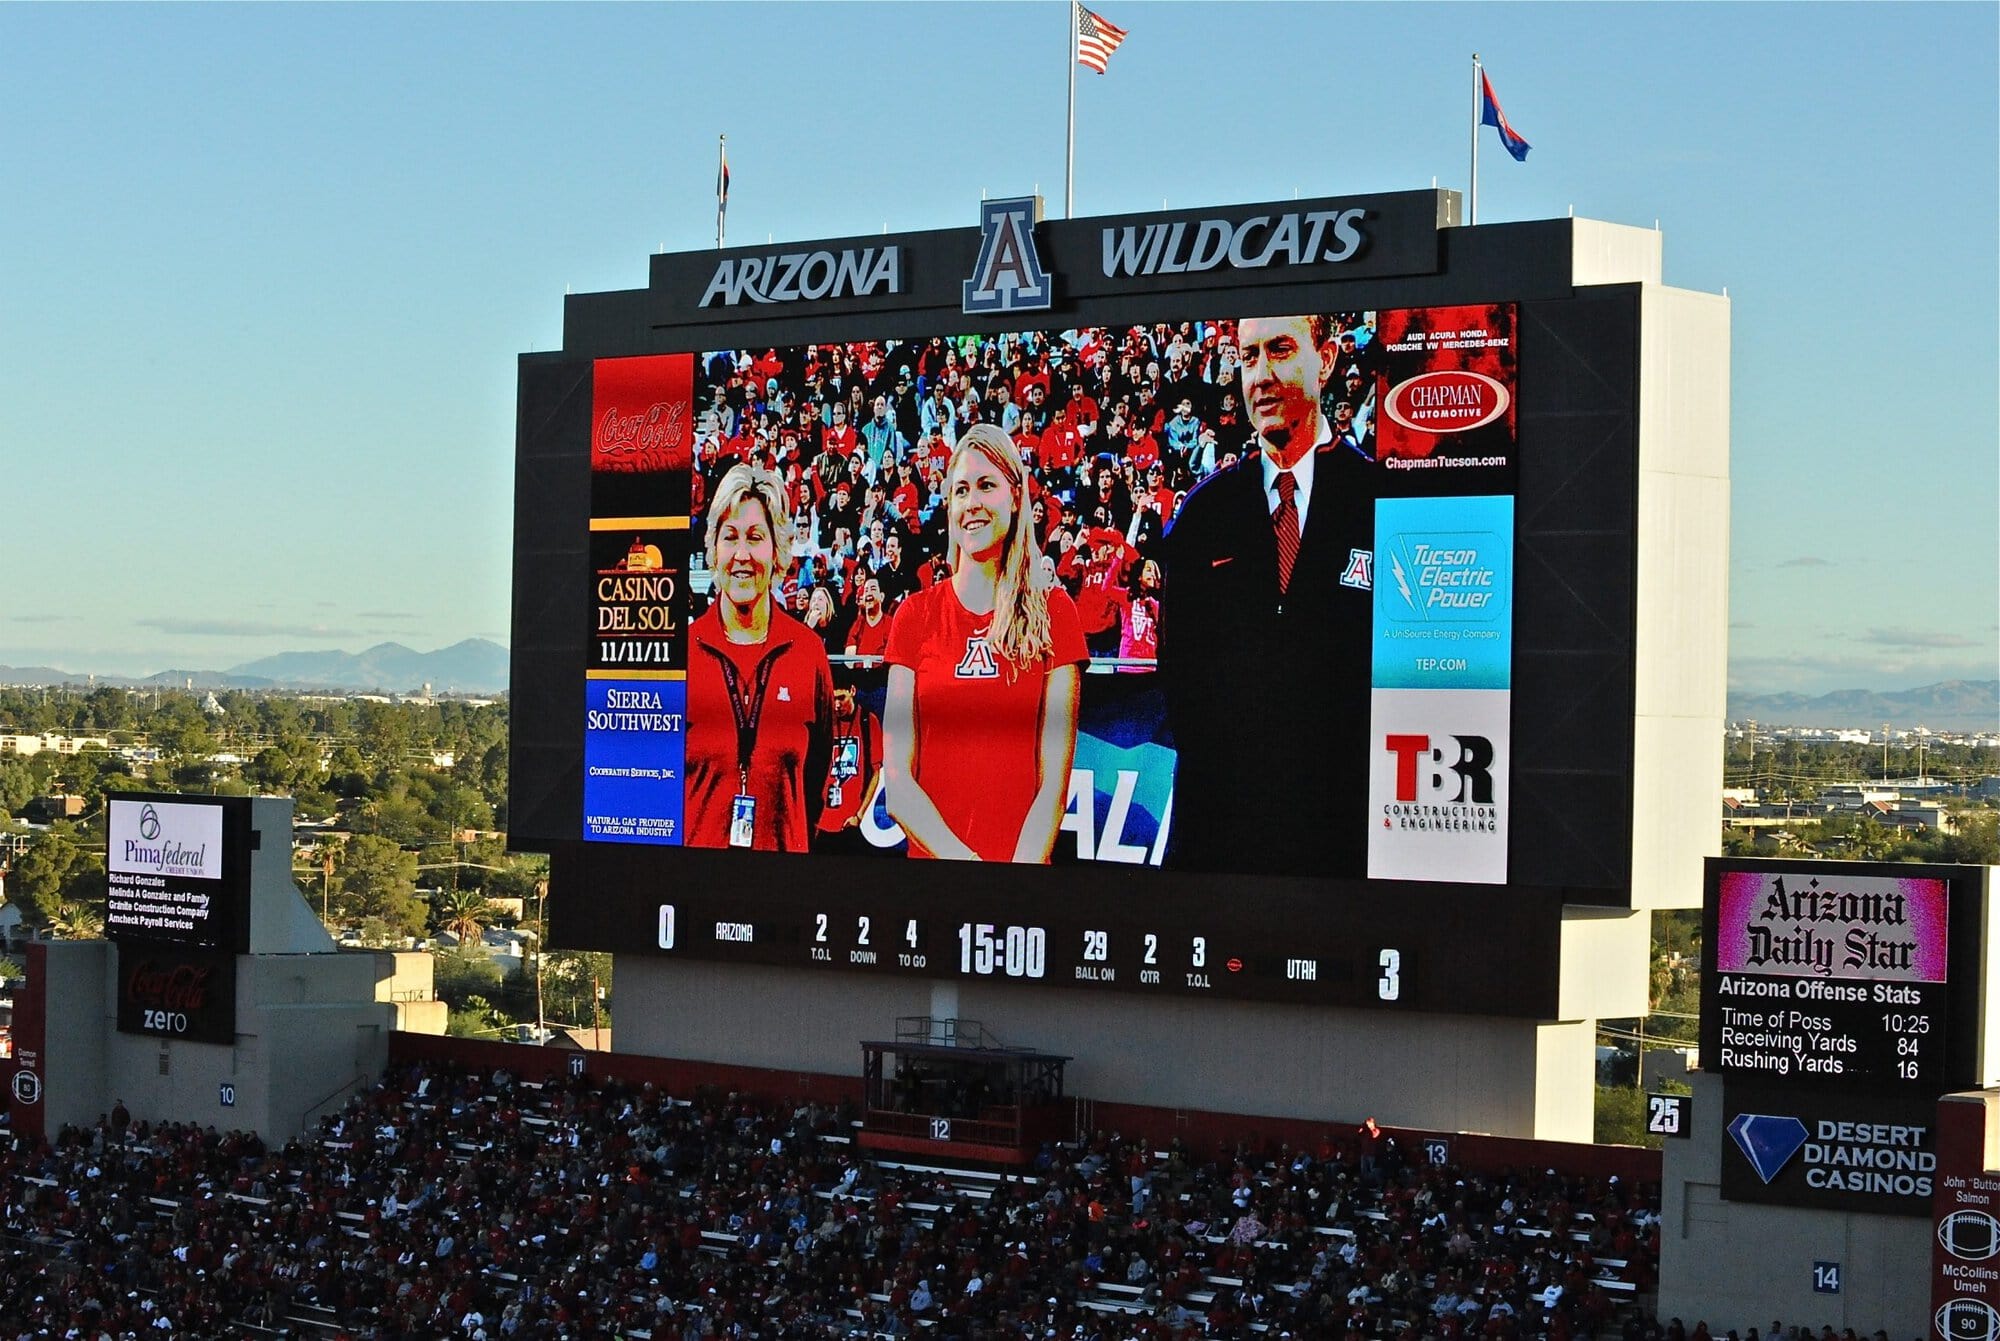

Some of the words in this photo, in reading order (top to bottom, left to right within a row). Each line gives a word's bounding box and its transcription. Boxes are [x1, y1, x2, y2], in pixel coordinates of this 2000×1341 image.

[698, 246, 899, 308] ARIZONA
[962, 197, 1053, 314] A
[1101, 208, 1366, 278] WILDCATS
[1386, 343, 1422, 352] PORSCHE
[1426, 342, 1438, 350] VW
[1442, 338, 1509, 349] MERCEDES-BENZ
[1407, 333, 1425, 341] AUDI
[1430, 331, 1456, 340] ACURA
[1460, 330, 1488, 338] HONDA
[1410, 384, 1482, 407] CHAPMAN
[1411, 408, 1482, 419] AUTOMOTIVE
[1385, 456, 1506, 471] ChapmanTucson.com
[1413, 544, 1476, 566] Tucson
[1419, 566, 1494, 587] Electric
[597, 577, 675, 602] CASINO
[1426, 587, 1493, 609] Power
[598, 606, 635, 631] DEL
[638, 606, 676, 631] SOL
[1434, 629, 1460, 640] Energy
[1463, 629, 1501, 640] Company
[600, 641, 669, 662] 11/11/11
[1415, 658, 1466, 670] TEP.COM
[607, 689, 662, 709] SIERRA
[588, 710, 682, 731] SOUTHWEST
[1385, 734, 1495, 804] TBR
[1383, 804, 1496, 818] CONSTRUCTION
[587, 816, 621, 826] NATURAL
[622, 817, 637, 827] GAS
[638, 818, 675, 828] PROVIDER
[591, 825, 602, 833] TO
[602, 825, 635, 835] ARIZONA
[636, 827, 673, 837] INDUSTRY
[1400, 818, 1496, 831] ENGINEERING
[109, 873, 134, 885] Richard
[135, 876, 165, 887] Gonzales
[109, 887, 134, 898] Melinda
[173, 891, 186, 902] and
[186, 892, 210, 906] Family
[1760, 874, 1908, 926] Arizona
[108, 913, 139, 925] Amcheck
[139, 915, 163, 928] Payroll
[164, 918, 194, 930] Services
[133, 902, 176, 914] Construction
[176, 905, 209, 920] Company
[658, 904, 675, 949] 0
[715, 921, 753, 942] ARIZONA
[816, 913, 828, 942] 2
[858, 916, 870, 945] 2
[906, 919, 917, 948] 4
[958, 922, 1046, 979] 15:00
[1083, 930, 1108, 961] 29
[1144, 933, 1157, 964] 2
[1192, 936, 1205, 967] 3
[1746, 921, 1836, 977] Daily
[1842, 927, 1918, 971] Star
[850, 950, 877, 964] DOWN
[898, 953, 911, 967] TO
[912, 955, 927, 968] GO
[1075, 966, 1099, 981] BALL
[1101, 967, 1115, 981] ON
[1140, 970, 1160, 984] QTR
[1286, 958, 1317, 981] UTAH
[1378, 948, 1400, 1001] 3
[1718, 976, 1791, 999] Arizona
[1795, 980, 1868, 1002] Offense
[1872, 983, 1921, 1005] Stats
[144, 1009, 187, 1032] zero
[1721, 1007, 1763, 1027] Time
[1768, 1011, 1785, 1028] of
[1789, 1011, 1832, 1031] Poss
[1881, 1014, 1930, 1034] 10:25
[1722, 1027, 1803, 1053] Receiving
[1808, 1032, 1857, 1053] Yards
[1896, 1037, 1919, 1057] 84
[571, 1059, 583, 1076] 11
[1720, 1048, 1790, 1075] Rushing
[1794, 1053, 1844, 1074] Yards
[1896, 1060, 1919, 1079] 16
[221, 1087, 234, 1104] 10
[1648, 1096, 1680, 1134] 25
[930, 1120, 949, 1139] 12
[1817, 1120, 1926, 1147] DESERT
[1425, 1144, 1446, 1164] 13
[1803, 1143, 1937, 1172] DIAMOND
[1805, 1168, 1933, 1197] CASINOS
[1943, 1175, 1966, 1189] John
[1955, 1190, 1990, 1205] Salmon
[1814, 1265, 1839, 1290] 14
[1942, 1263, 1999, 1280] McCollins
[1953, 1279, 1987, 1293] Umeh
[1960, 1318, 1977, 1331] 90
